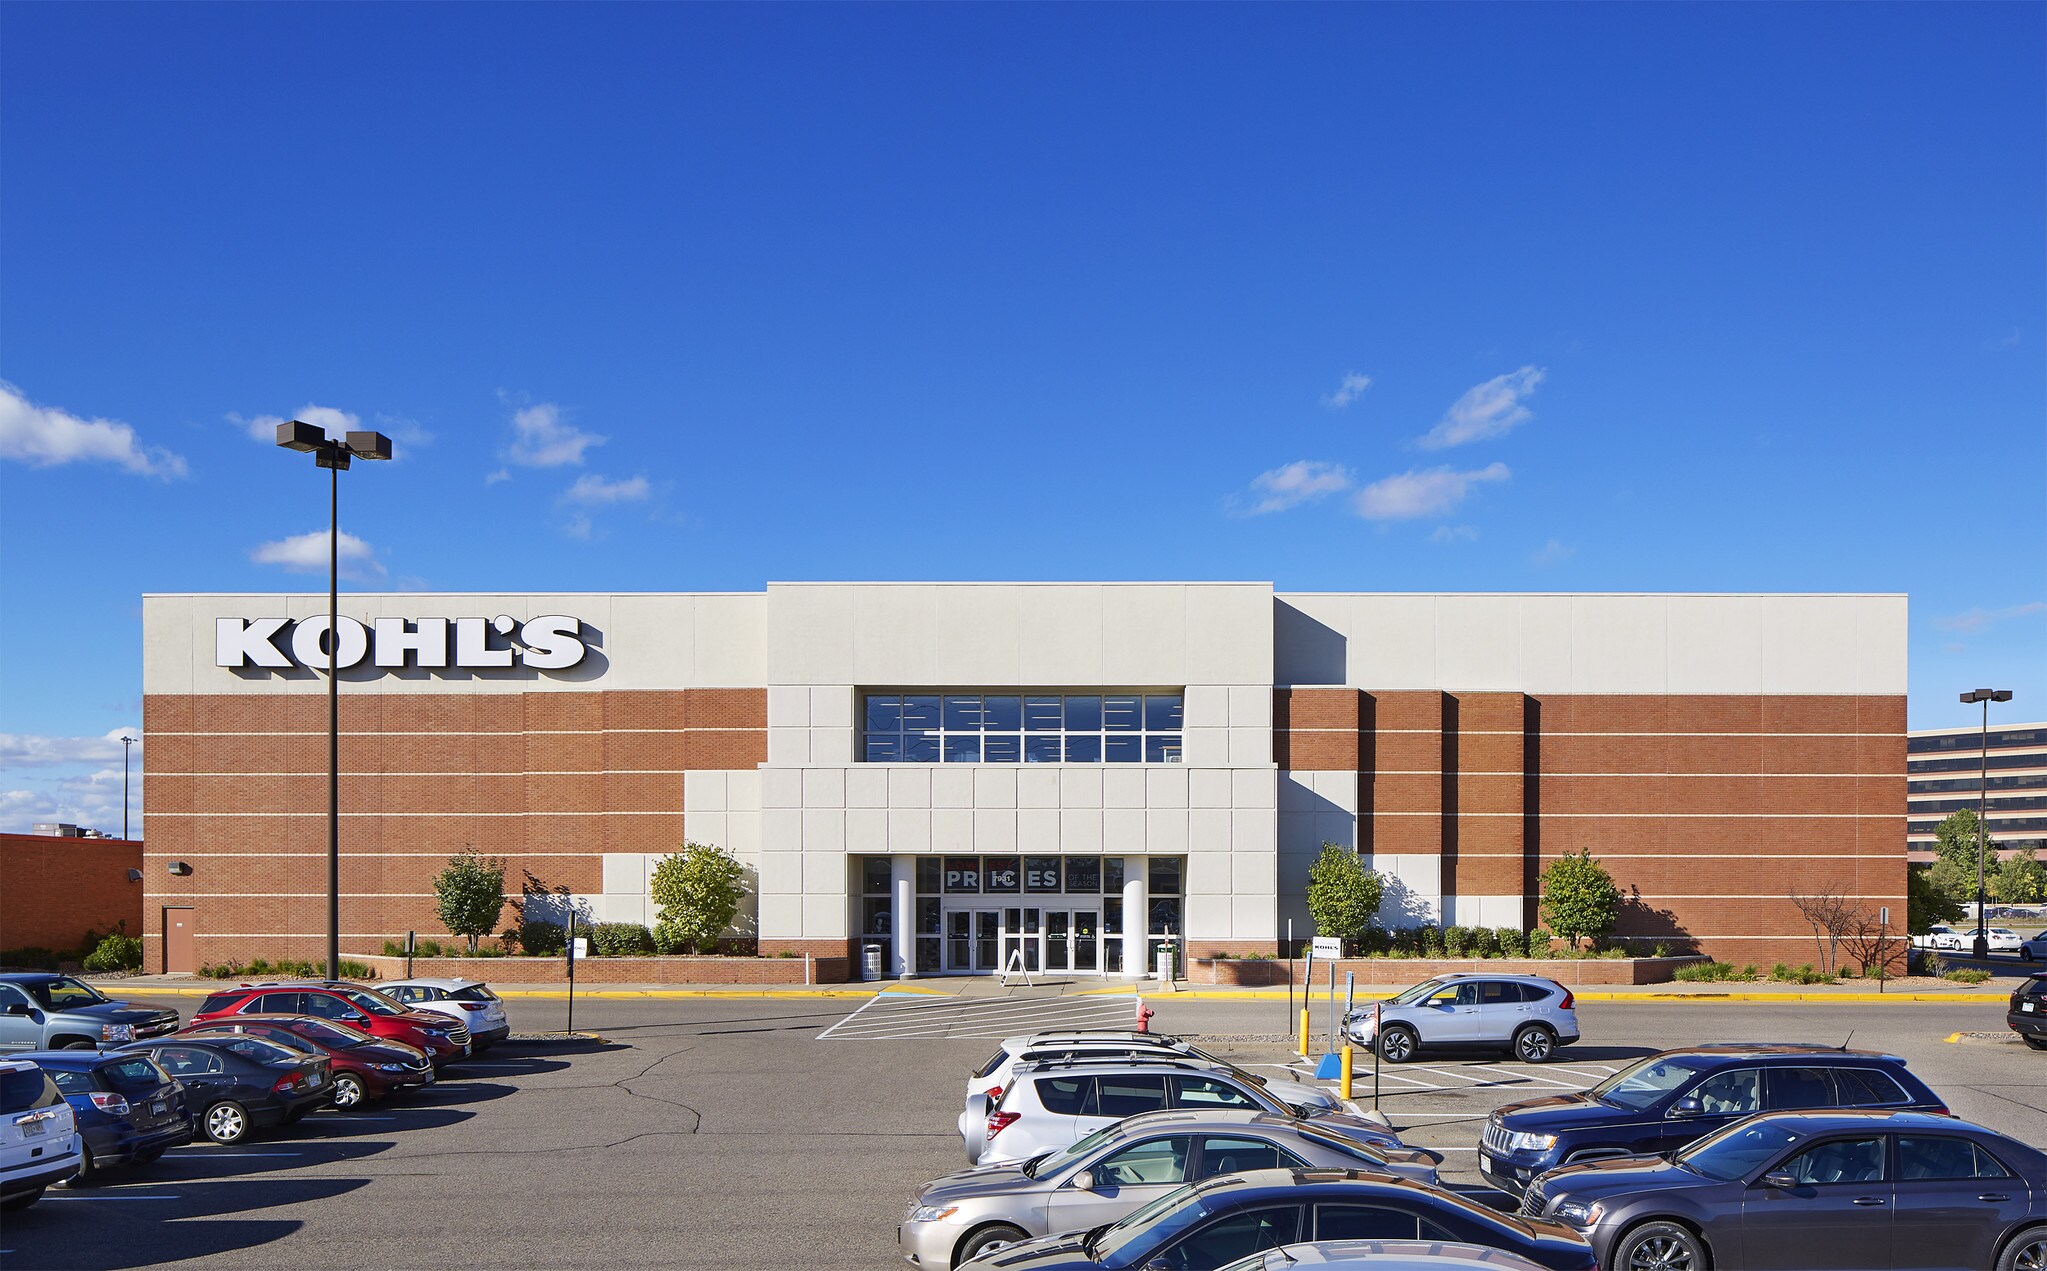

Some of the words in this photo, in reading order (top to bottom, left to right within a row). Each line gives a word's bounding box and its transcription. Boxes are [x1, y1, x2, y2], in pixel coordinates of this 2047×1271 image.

[216, 614, 586, 669] KOHL'S
[1067, 873, 1080, 881] OF
[1082, 873, 1097, 881] THE
